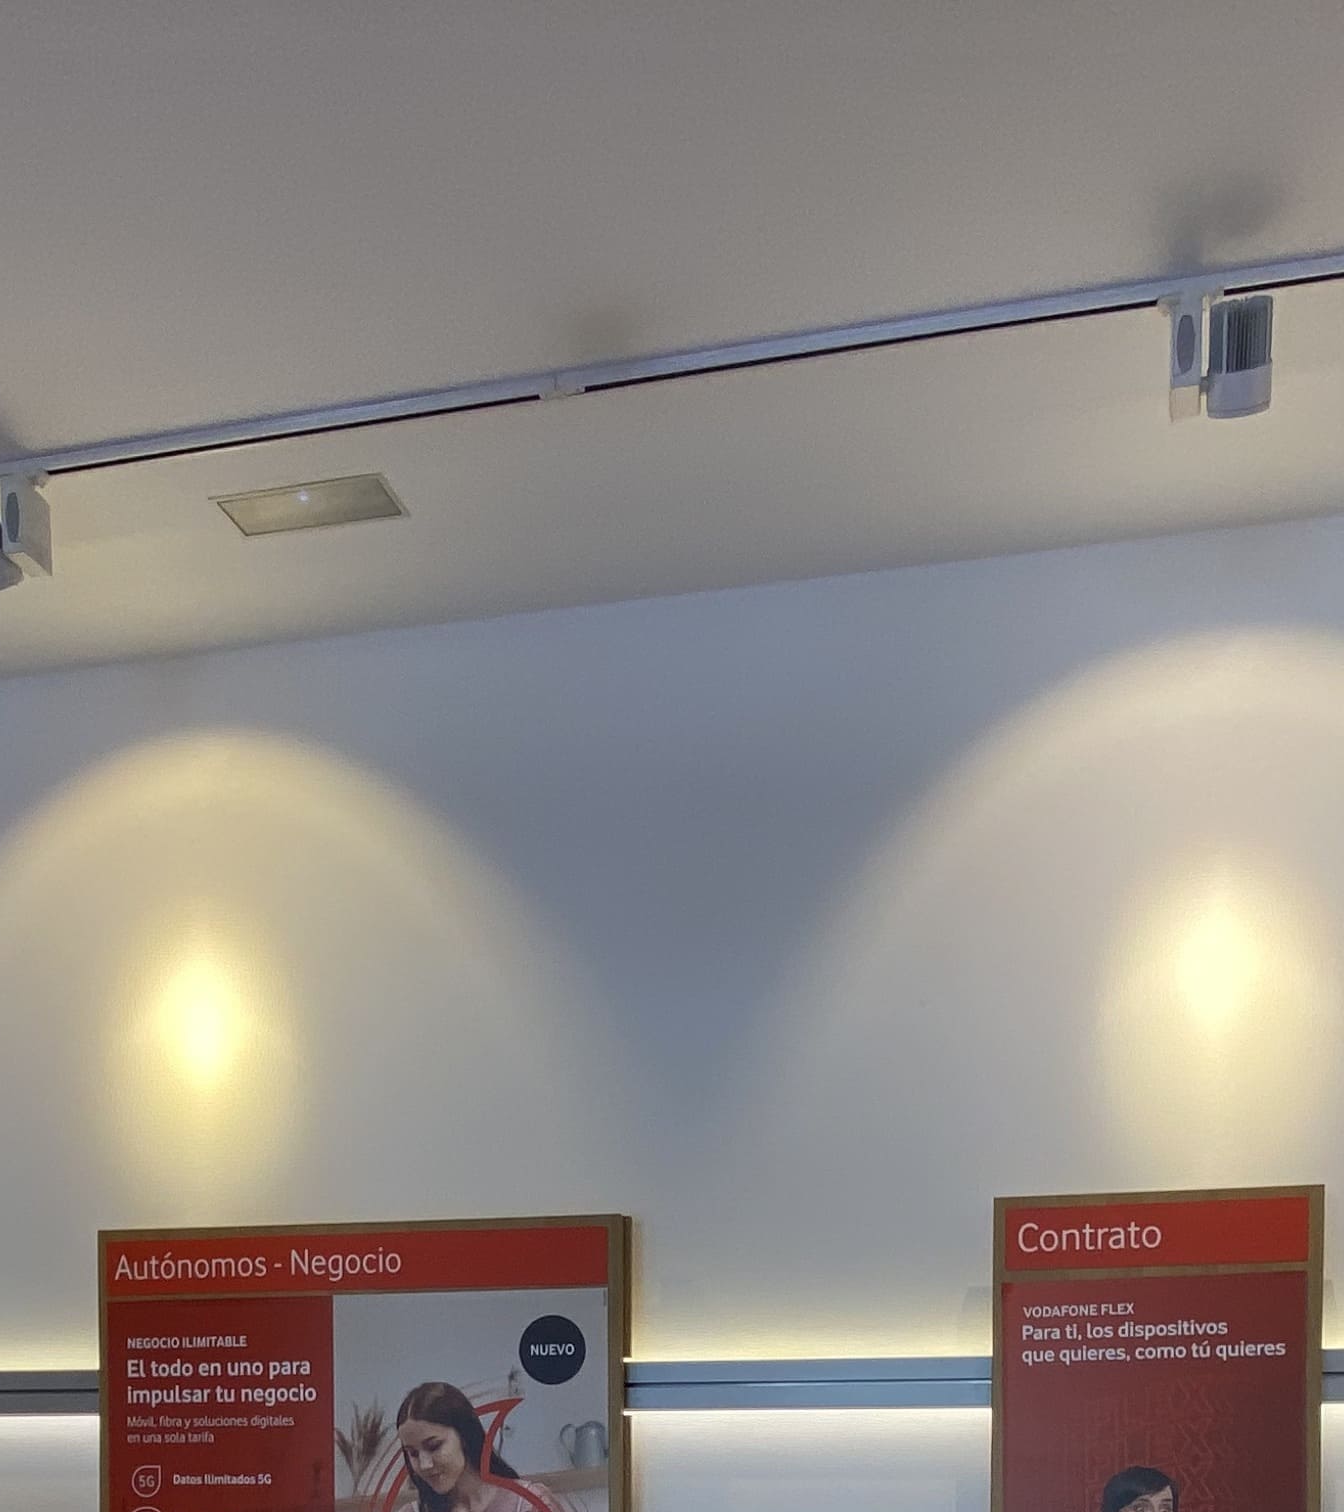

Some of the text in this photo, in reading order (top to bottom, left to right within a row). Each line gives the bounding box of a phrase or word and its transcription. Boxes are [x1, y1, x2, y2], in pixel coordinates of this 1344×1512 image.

[1018, 1221, 1162, 1253] Contrato
[115, 1252, 268, 1281] Autónomos
[290, 1247, 402, 1282] Negocio
[1023, 1303, 1135, 1318] VODAFONE FLEX
[1022, 1319, 1228, 1342] Para ti, los dispositivos
[127, 1335, 248, 1350] NEGOCIO ILIMITABLE
[530, 1343, 575, 1356] NUEVO
[1022, 1339, 1286, 1366] que quieres, como tú quieres
[127, 1358, 311, 1380] El todo en uno para
[127, 1383, 317, 1408] impulsar tu negocio
[159, 1415, 182, 1427] fibra
[183, 1418, 192, 1429] y
[193, 1415, 248, 1427] soluciones
[250, 1414, 295, 1429] digitales
[127, 1431, 214, 1443] en una sola tarifa
[139, 1475, 155, 1487] 5G
[173, 1473, 272, 1485] Datos Ilimitados 5G
